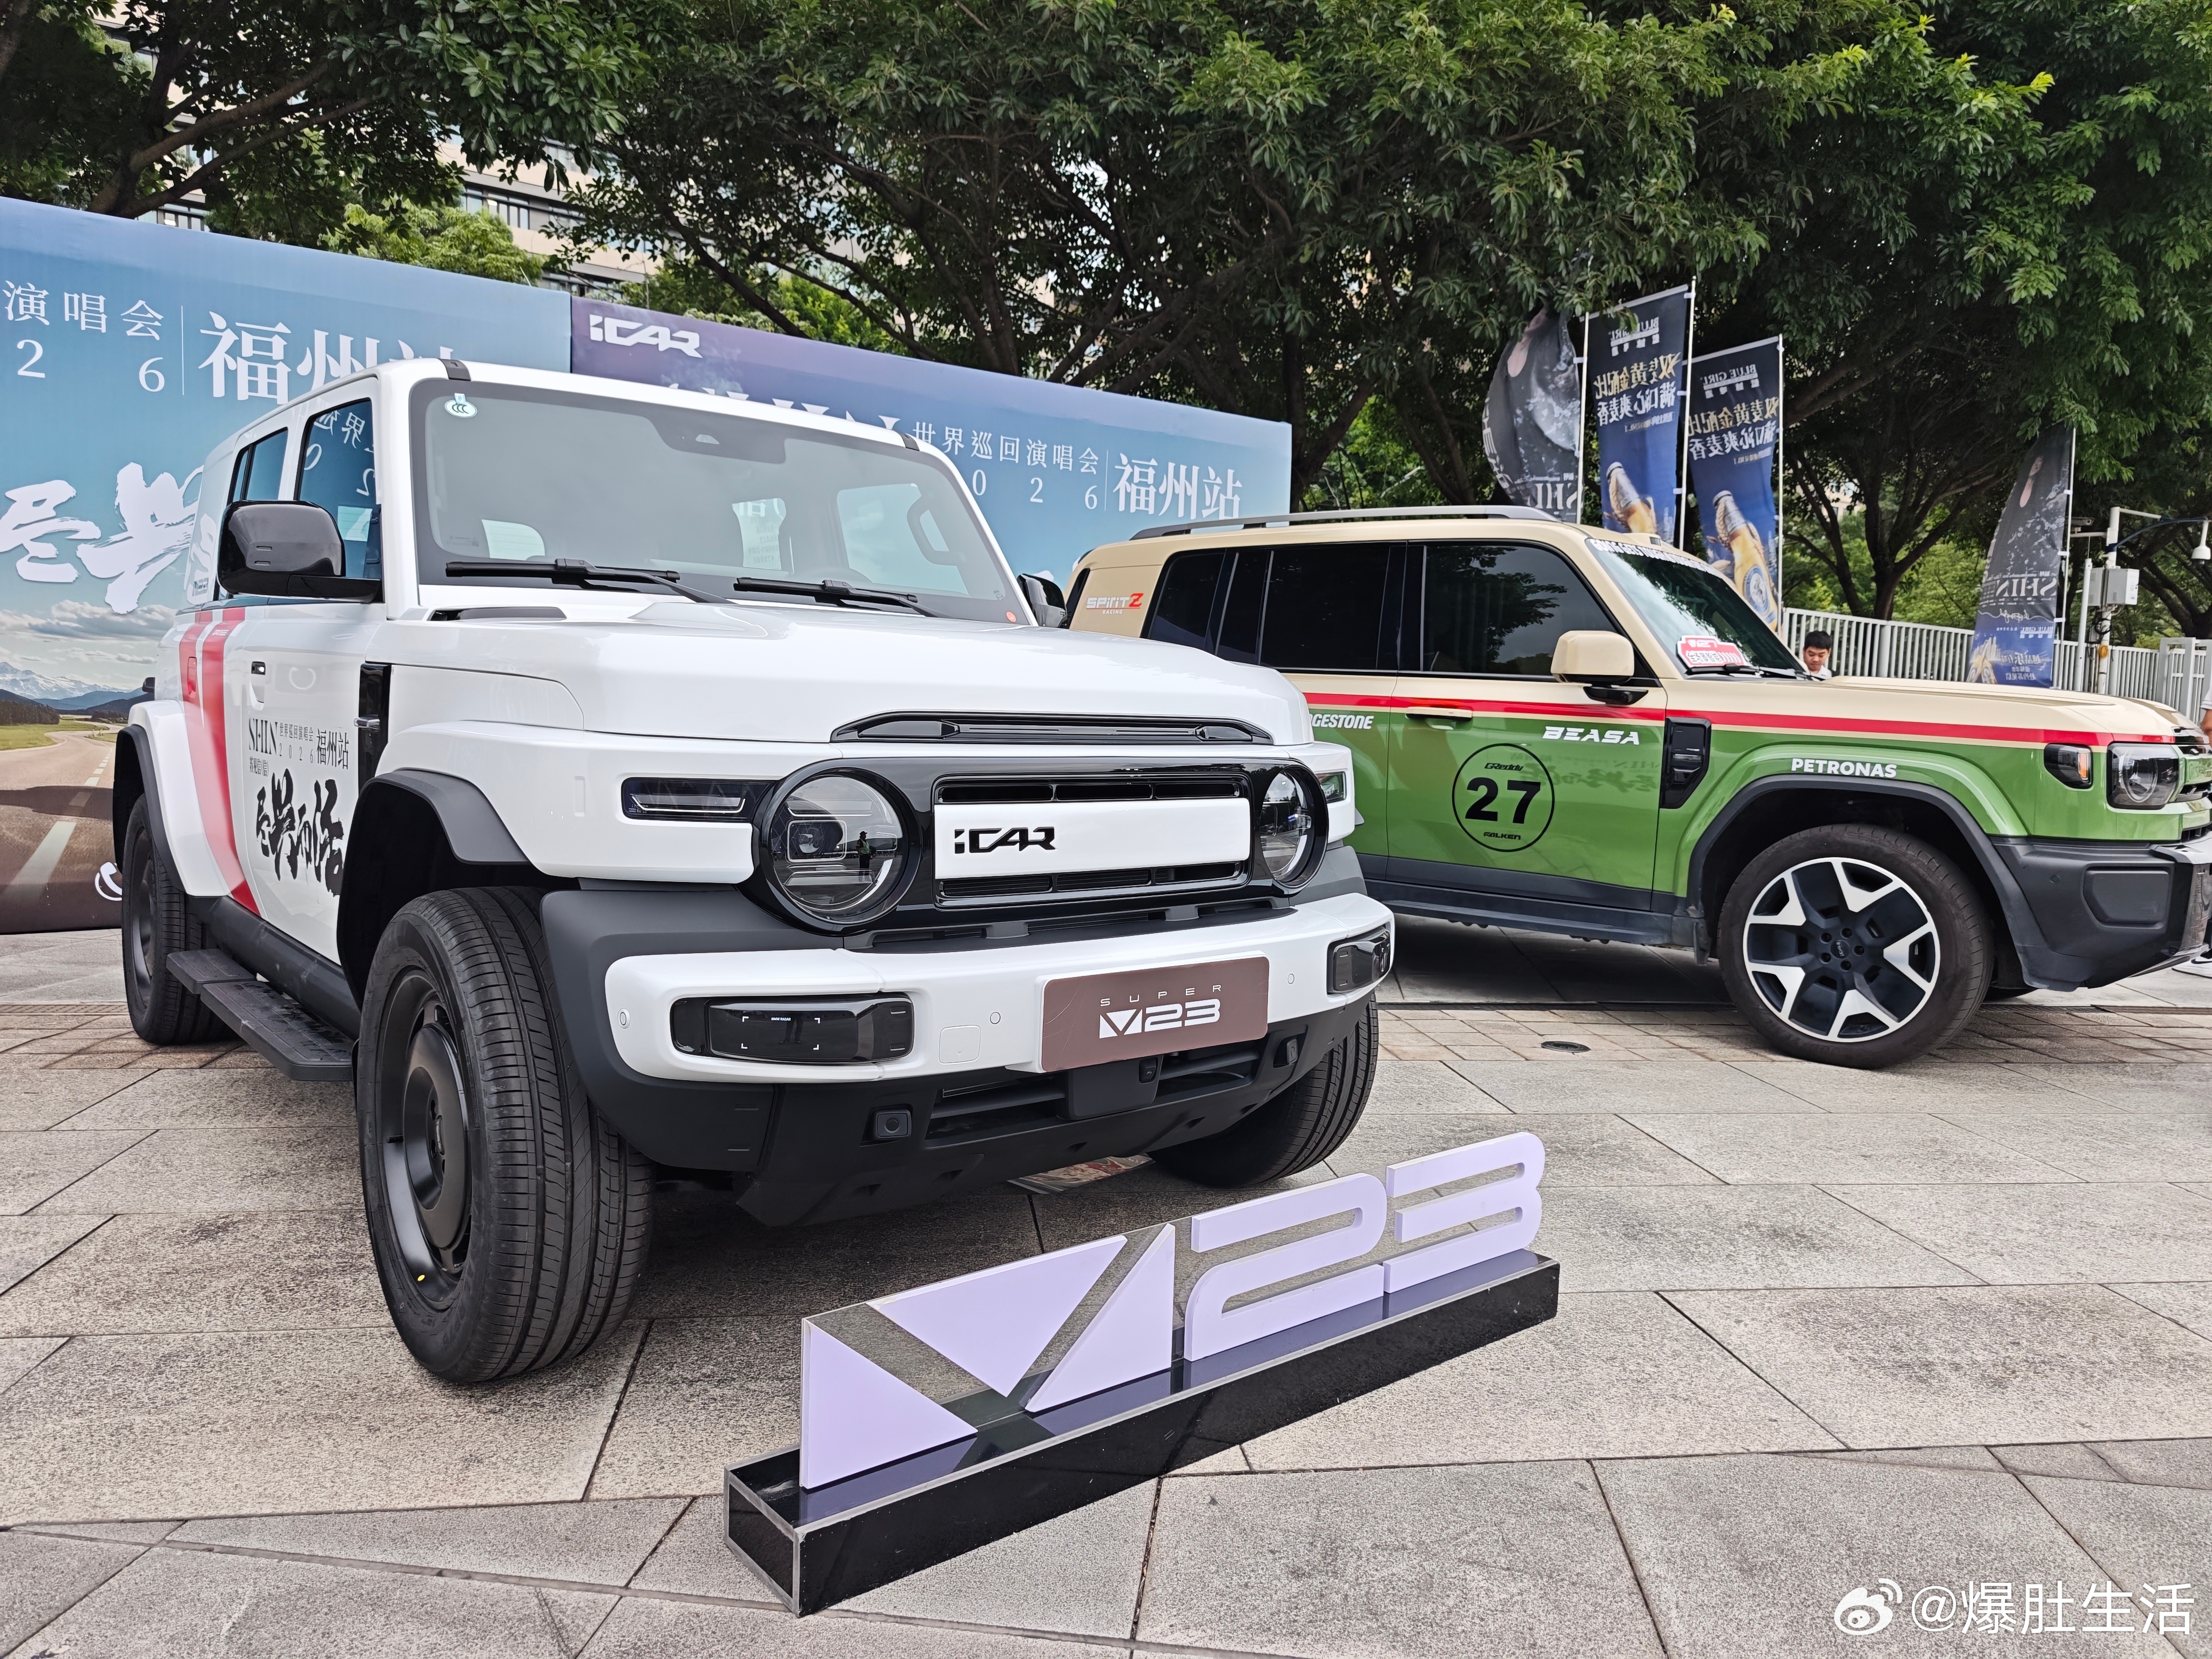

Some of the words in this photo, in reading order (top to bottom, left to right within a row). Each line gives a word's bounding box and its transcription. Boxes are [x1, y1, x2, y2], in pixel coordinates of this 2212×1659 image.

[3, 281, 164, 341] 演唱会
[199, 312, 454, 405] 福州
[913, 421, 1099, 475] 世界巡回演唱会
[1113, 453, 1243, 520] 福州站
[248, 718, 278, 755] SHIN
[316, 729, 349, 770] 福州站
[1542, 726, 1640, 745] BEASA
[1791, 758, 1897, 778] PETRONAS
[1465, 777, 1541, 824] 27
[1100, 984, 1222, 1007] SUPER
